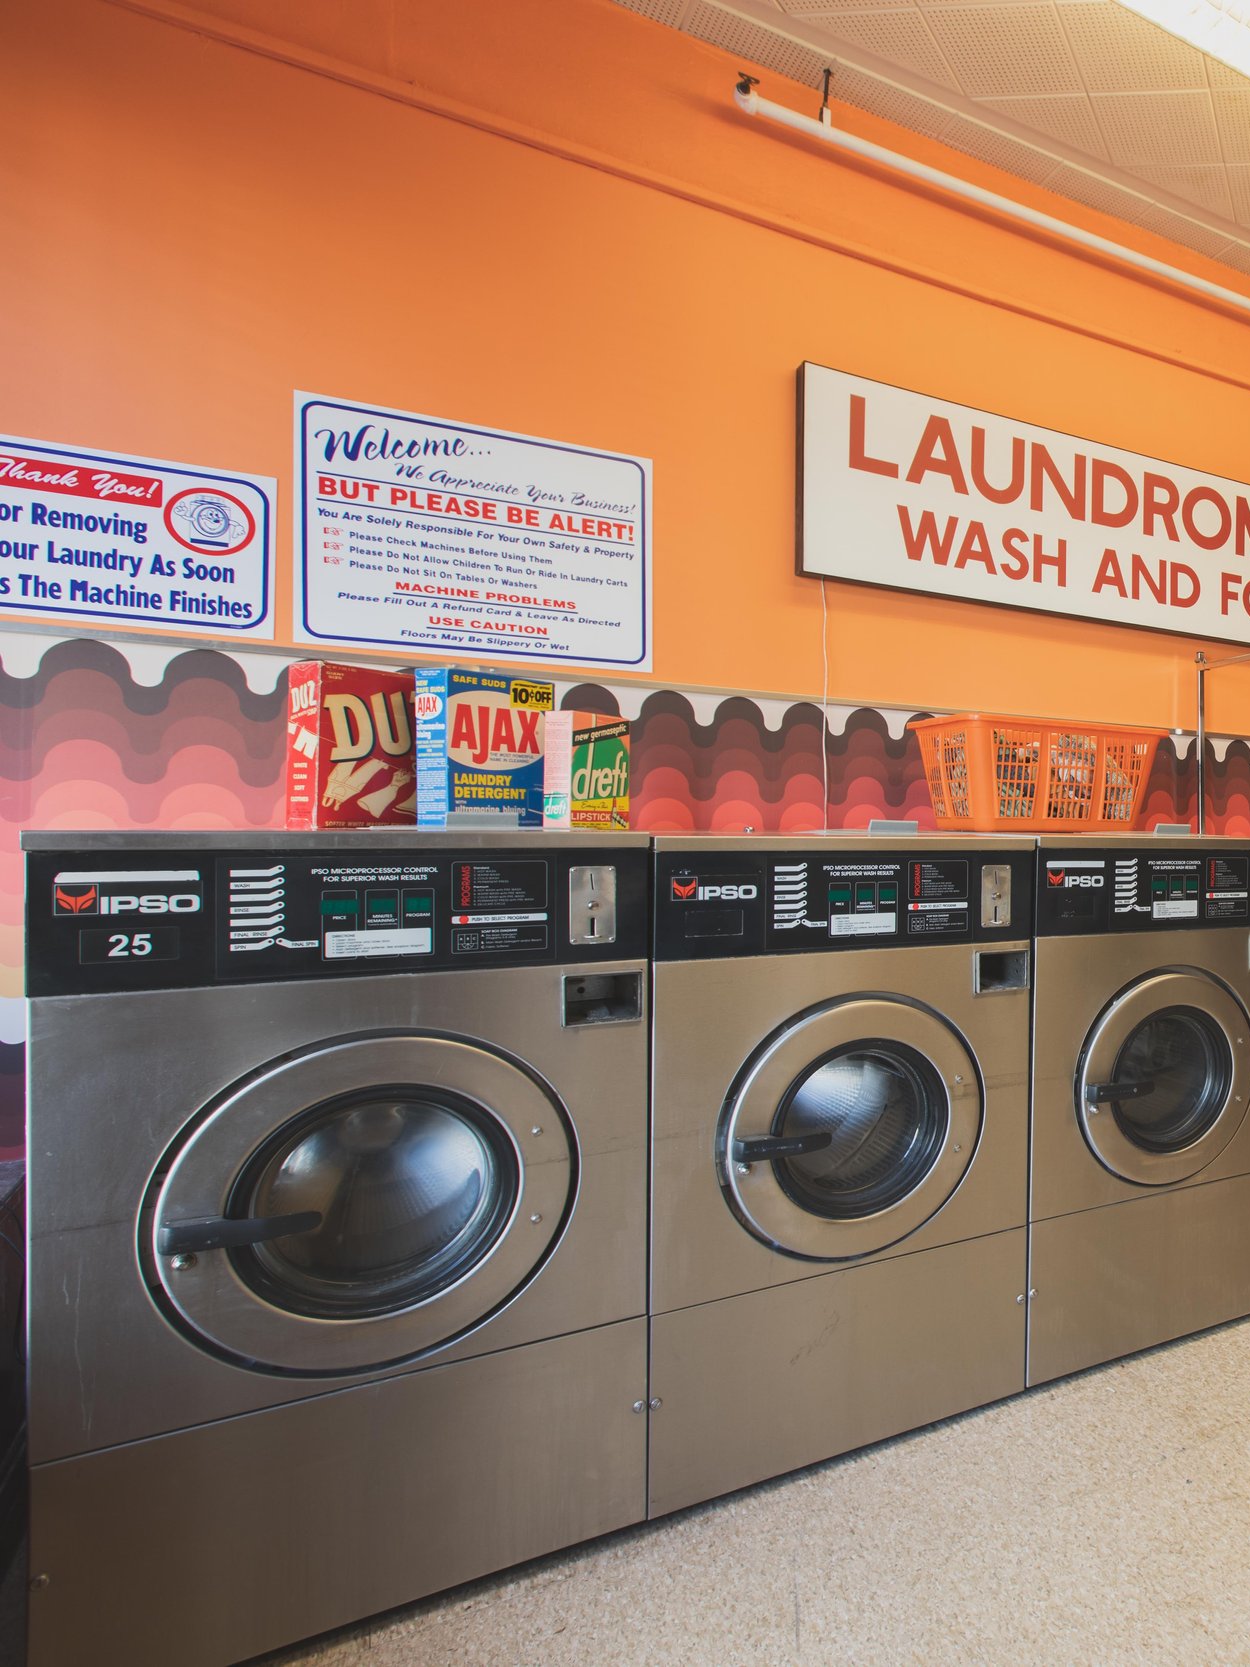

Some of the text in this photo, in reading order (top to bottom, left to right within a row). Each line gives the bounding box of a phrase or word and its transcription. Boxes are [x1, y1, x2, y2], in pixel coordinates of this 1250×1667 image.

[314, 424, 491, 462] Welcome...
[0, 457, 160, 499] Thank You!
[395, 463, 636, 515] We Appreciate Your Business!
[0, 502, 148, 544] or Removing
[318, 476, 634, 542] BUT PLEASE BE ALERT!
[317, 508, 338, 519] You
[342, 512, 362, 522] Are
[366, 514, 402, 528] Solely
[405, 521, 473, 537] Responsible
[476, 531, 494, 541] For
[498, 533, 520, 544] Your
[523, 537, 545, 548] Own
[549, 540, 580, 553] Safety
[594, 547, 635, 561] Property
[350, 531, 553, 565] Please Check Machines Before Using Them
[0, 540, 235, 584] our Laundry As Soon
[350, 545, 628, 588] Please Do Not Allow Children To Run Or Ride In Laundry Carts
[896, 504, 1067, 588] WASH
[1091, 548, 1201, 608] AND
[350, 560, 538, 589] Please Do Not Sit On Tables Or Washers
[18, 573, 62, 600] The
[70, 578, 162, 610] Machine
[170, 590, 253, 620] Finishes
[338, 592, 380, 603] Please
[384, 596, 402, 605] Fill
[406, 600, 427, 608] Out
[442, 603, 483, 613] Refund
[486, 607, 511, 616] Card
[527, 612, 559, 622] Leave
[562, 615, 575, 623] As
[578, 617, 621, 628] Directed
[395, 581, 577, 610] MACHINE PROBLEMS
[400, 630, 437, 640] Floors
[441, 633, 464, 643] May
[468, 635, 483, 643] Be
[487, 637, 531, 648] Slippery
[550, 643, 570, 651] Wet
[428, 616, 548, 635] USE CAUTION
[291, 679, 317, 714] DUZ
[453, 674, 506, 688] SAFE SUDS
[417, 696, 437, 716] AJAX
[322, 687, 416, 762] DU
[450, 703, 540, 765] AJAX
[574, 732, 590, 742] new
[454, 772, 512, 786] LAUNDRY
[572, 743, 627, 800] dreft
[454, 786, 526, 800] DETERGENT
[544, 793, 567, 815] dreft
[571, 812, 611, 821] LIPSTICK
[461, 865, 471, 907] PROGRAMS
[698, 884, 758, 900] IPSO
[1064, 875, 1104, 888] IPSO
[100, 894, 200, 915] IPSO
[108, 933, 152, 957] 25
